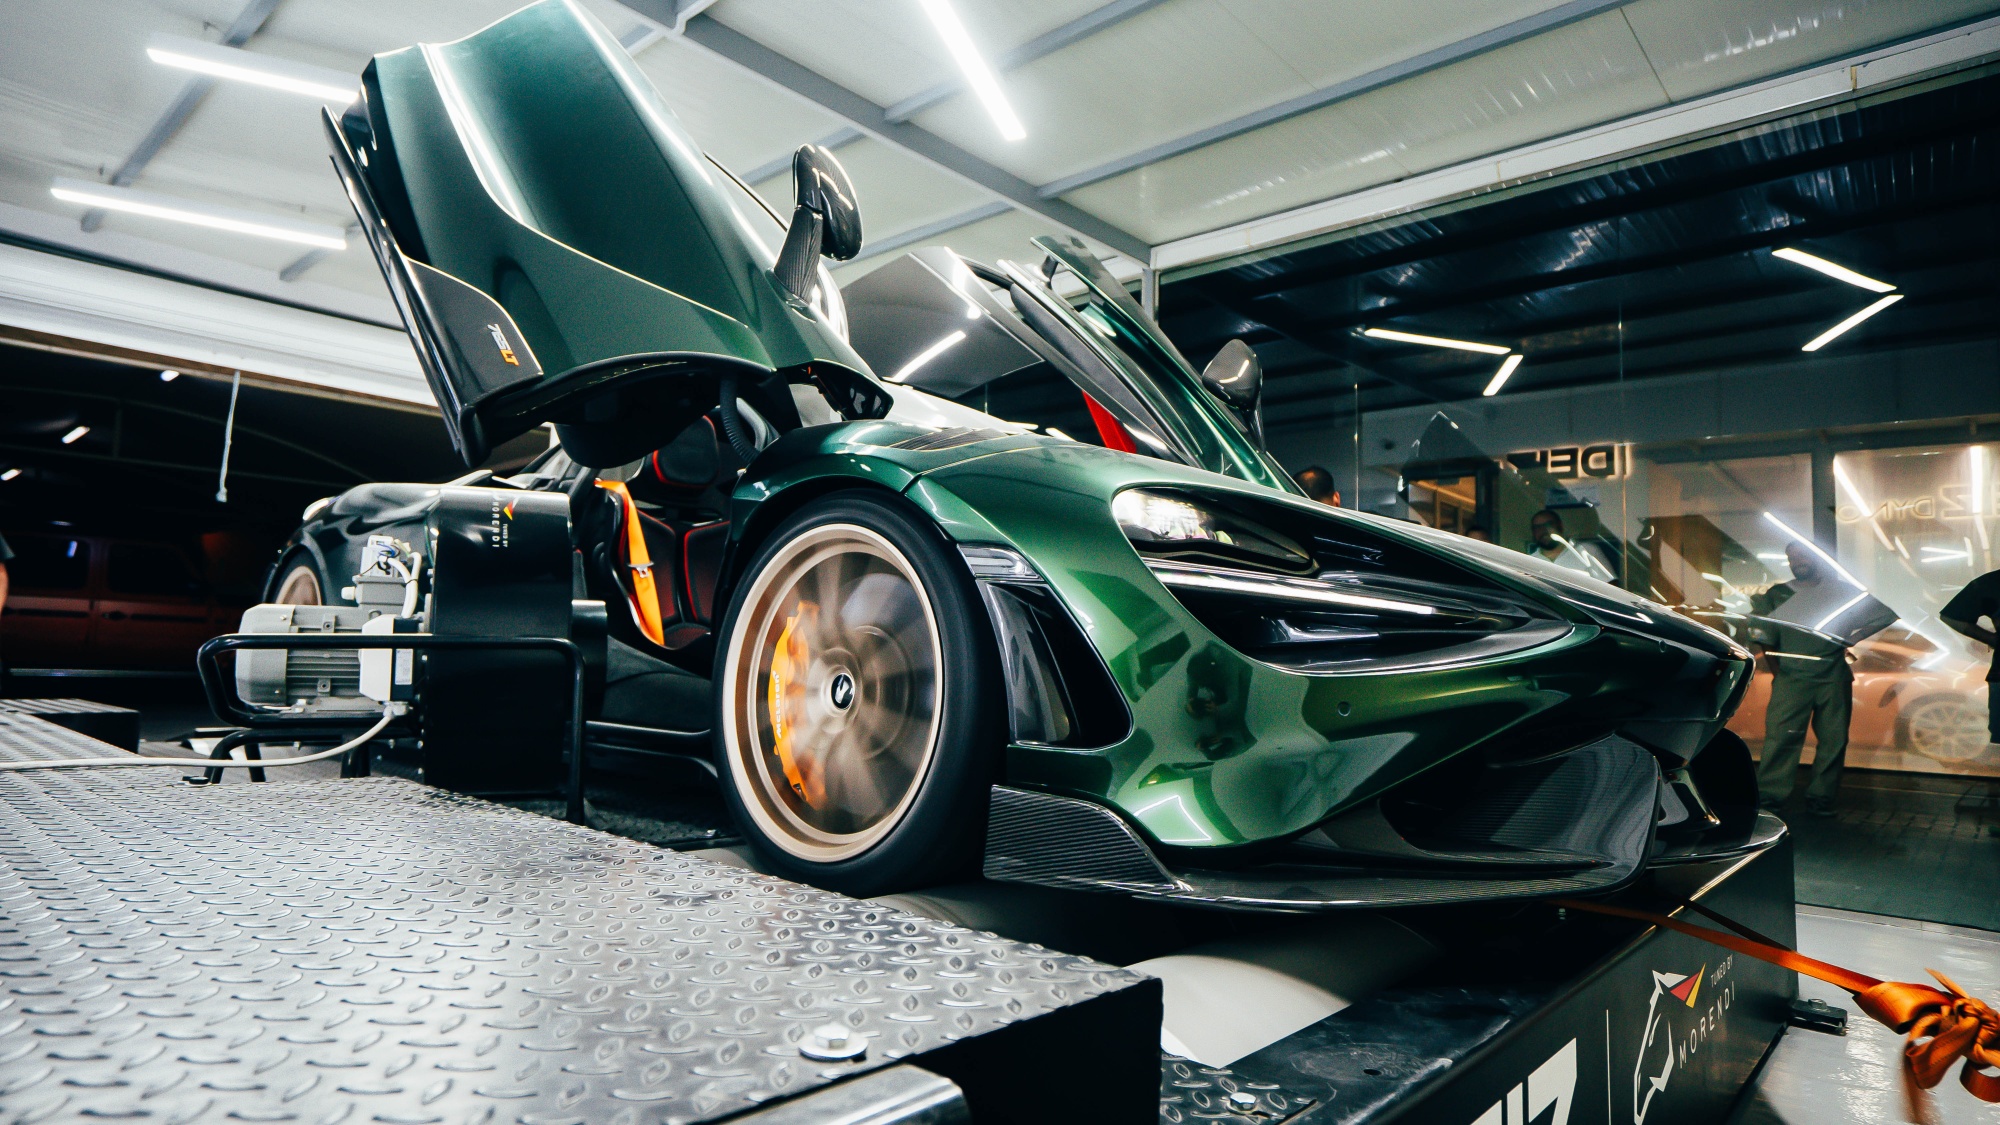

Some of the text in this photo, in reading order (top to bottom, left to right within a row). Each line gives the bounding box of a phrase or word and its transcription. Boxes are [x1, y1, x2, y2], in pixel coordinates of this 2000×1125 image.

[1711, 955, 1733, 988] TUNED BY
[1680, 981, 1735, 1069] MORENDI
